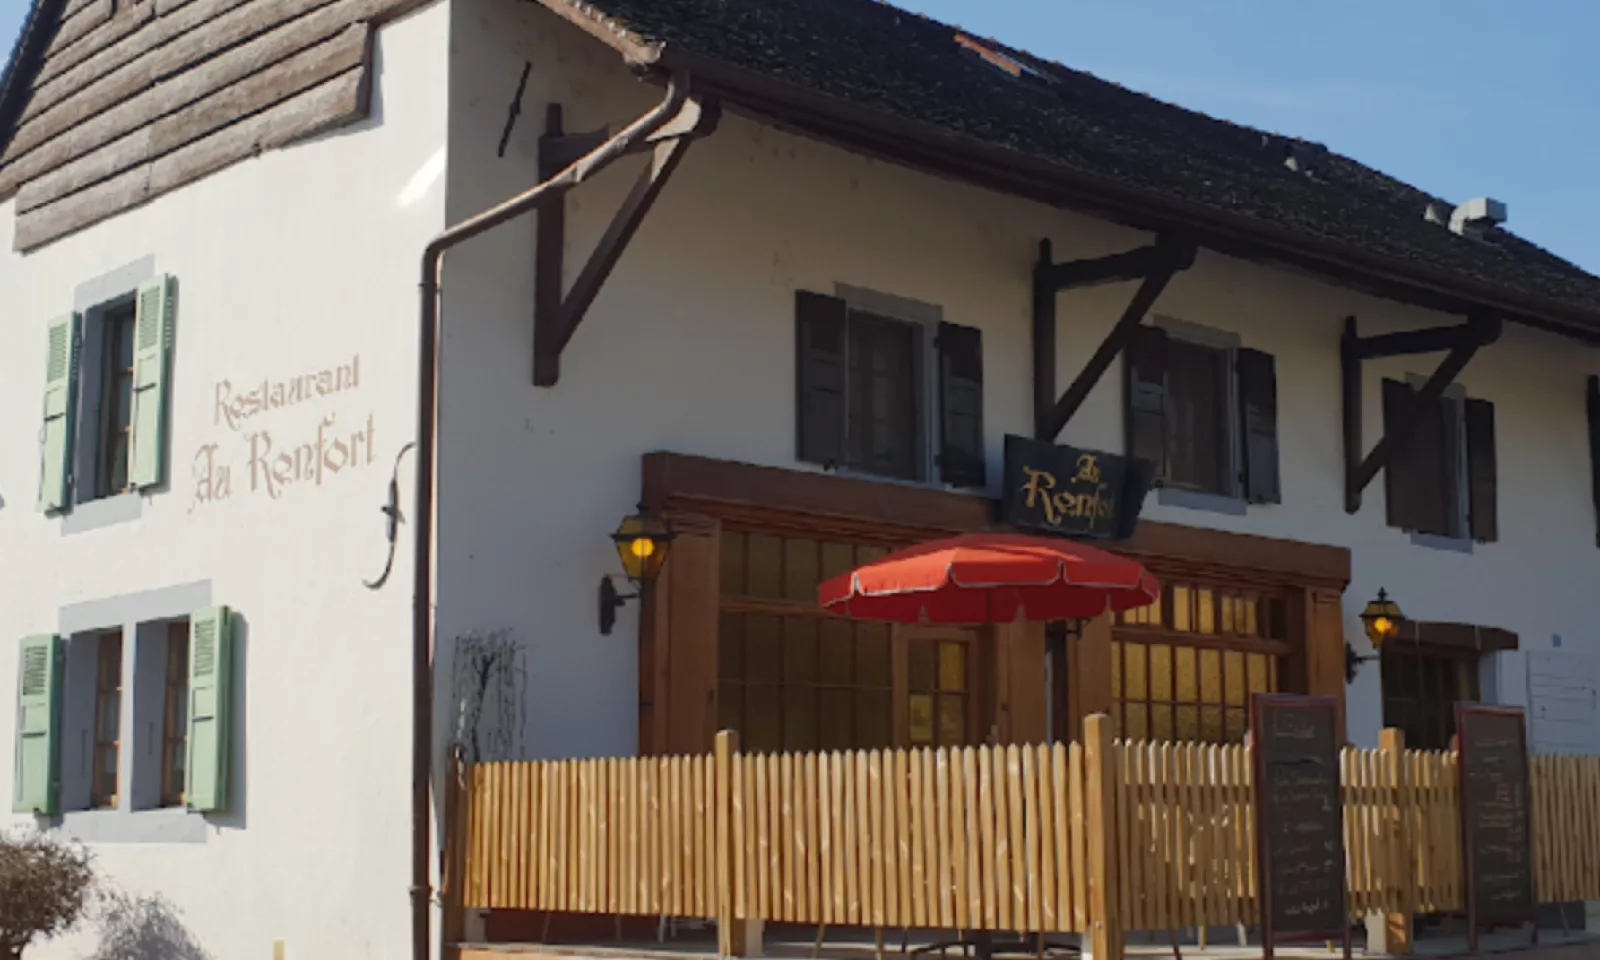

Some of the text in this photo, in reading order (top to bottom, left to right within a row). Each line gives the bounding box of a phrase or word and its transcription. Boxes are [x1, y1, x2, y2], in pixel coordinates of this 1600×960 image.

[213, 352, 360, 432] Restaurant
[188, 411, 375, 514] Au Renfort
